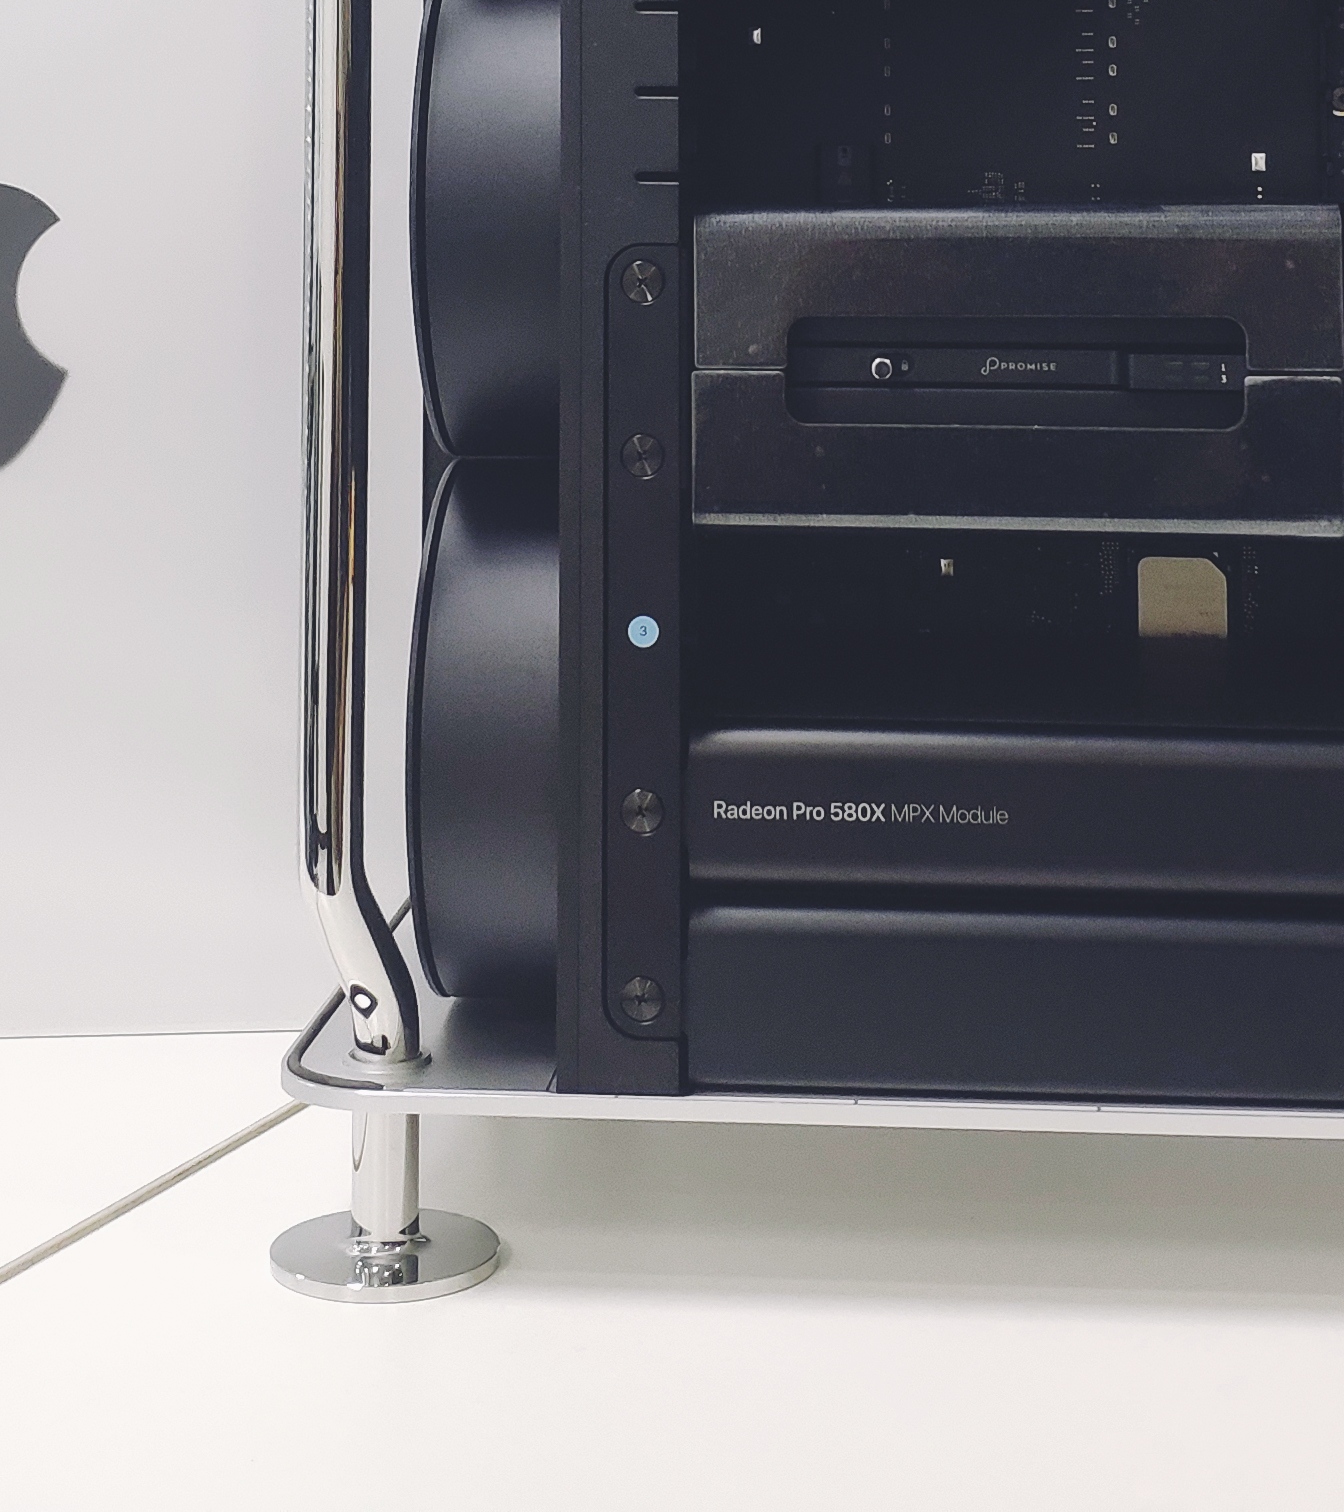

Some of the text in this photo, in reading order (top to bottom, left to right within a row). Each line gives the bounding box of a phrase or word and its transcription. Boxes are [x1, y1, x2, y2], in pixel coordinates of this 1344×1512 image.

[1000, 361, 1057, 371] PROMISE
[639, 625, 648, 637] 3
[713, 800, 1009, 825] Radeon Pro 580X MPX Module
